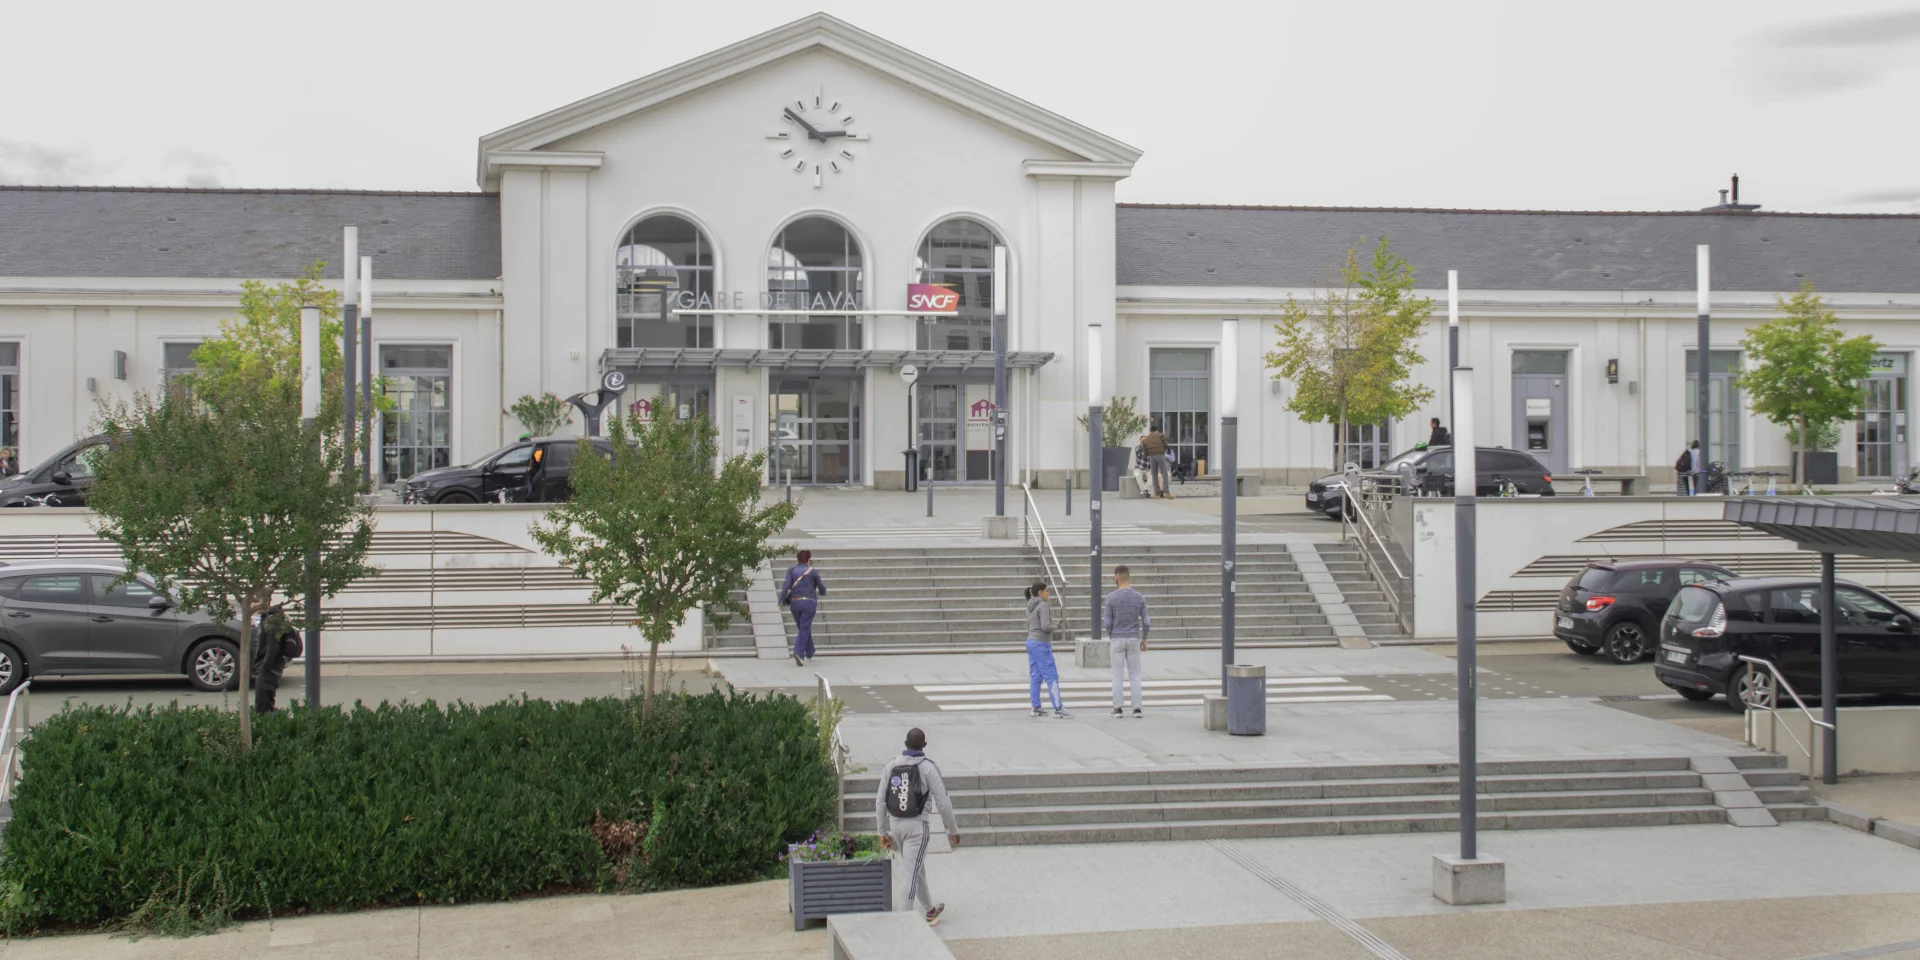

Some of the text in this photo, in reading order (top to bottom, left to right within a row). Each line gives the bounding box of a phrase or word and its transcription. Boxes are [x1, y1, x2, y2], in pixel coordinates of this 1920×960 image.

[678, 290, 870, 311] GARE DE LAVA
[909, 294, 955, 309] SNCF
[898, 772, 909, 811] adidas
